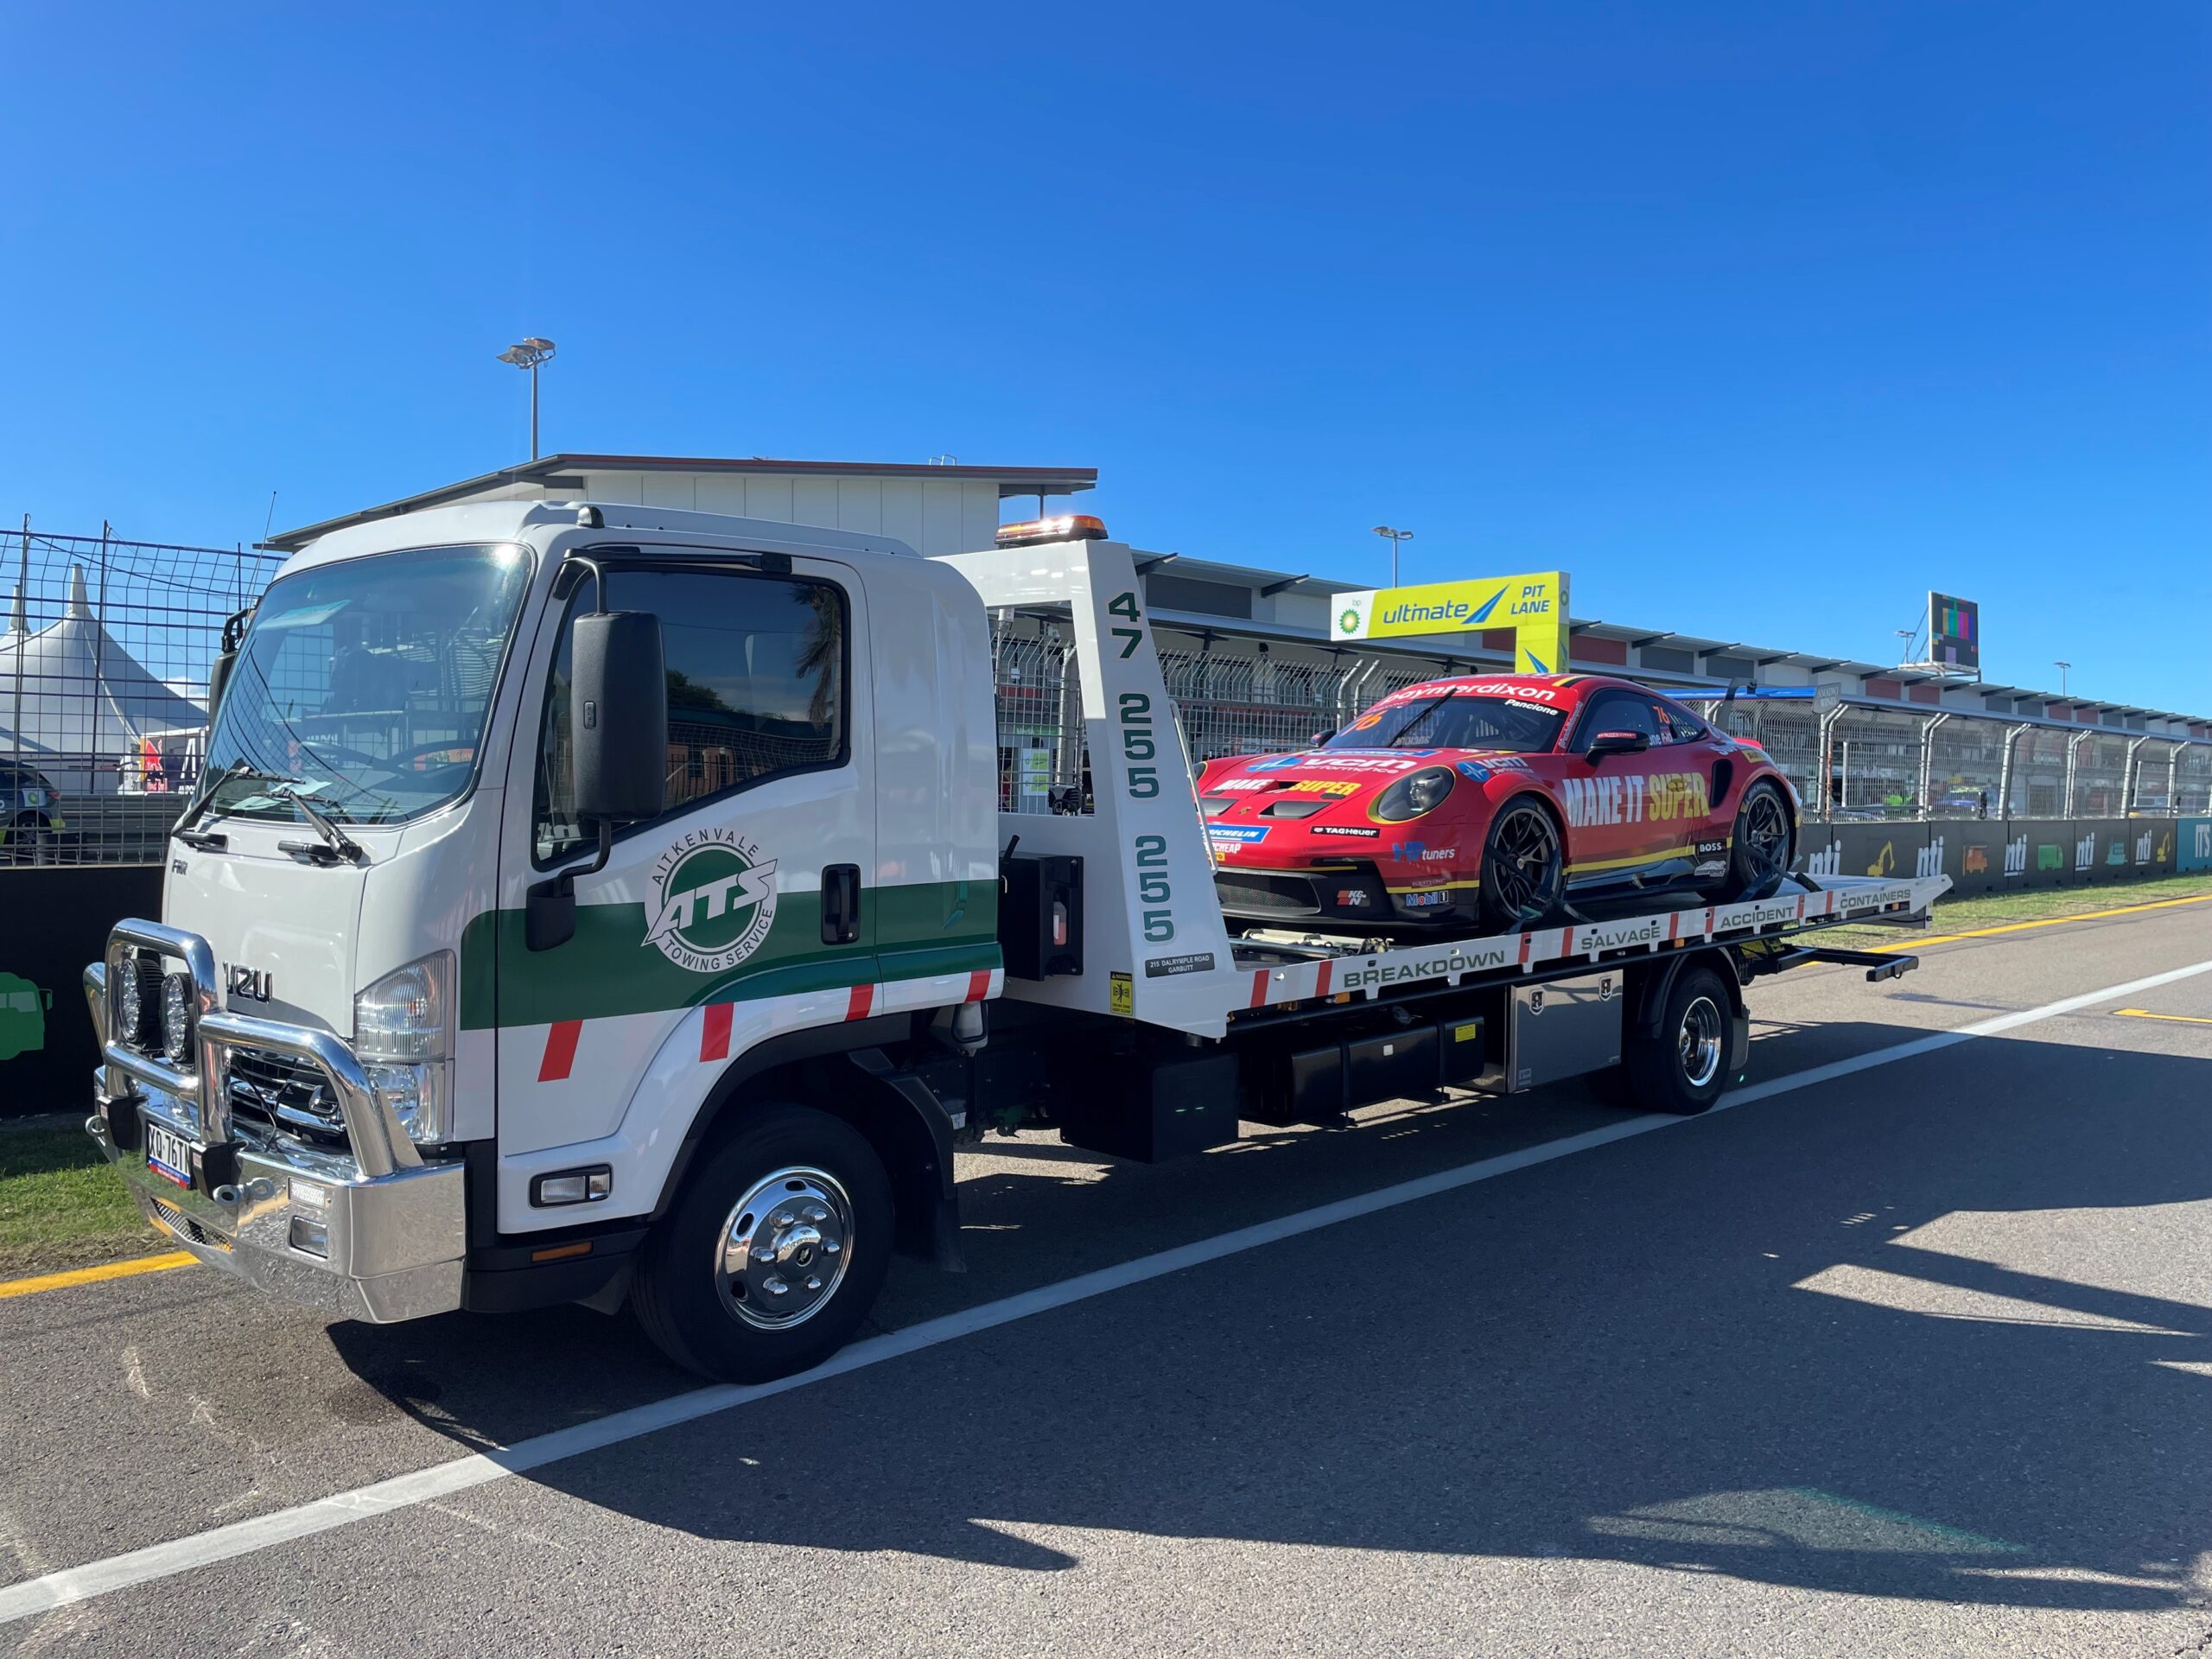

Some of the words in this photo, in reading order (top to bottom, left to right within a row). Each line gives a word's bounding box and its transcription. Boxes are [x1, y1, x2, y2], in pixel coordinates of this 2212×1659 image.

[1522, 584, 1546, 598] PIT
[1383, 600, 1469, 624] ultimate
[1510, 600, 1550, 615] LANE
[1380, 683, 1556, 705] paynterdixon
[1504, 699, 1559, 715] Pancione
[1652, 705, 1670, 725] 76
[1292, 765, 1399, 774] performance
[1304, 759, 1417, 769] vcm
[1475, 756, 1529, 769] vcm
[1213, 779, 1274, 791] MAKE
[1287, 779, 1362, 795] SUPER
[1562, 776, 1623, 828] MAKE
[1624, 774, 1644, 823] IT
[1649, 772, 1711, 822] SUPER
[652, 828, 759, 886] AITKENVALE
[1392, 840, 1425, 862] HP
[1421, 848, 1455, 861] tuners
[1700, 842, 1722, 853] BOSS
[1808, 839, 1841, 875] nti
[1916, 836, 1943, 878] nti
[2005, 834, 2027, 872] nti
[2075, 832, 2094, 867] nti
[640, 858, 778, 947] ATS
[1407, 892, 1438, 906] Mobil
[1840, 888, 1911, 910] CONTAINERS
[1721, 906, 1795, 929] ACCIDENT
[664, 939, 721, 971] TOWING
[727, 908, 772, 965] SERVICE
[1581, 925, 1661, 951] SALVAGE
[1161, 957, 1194, 966] DALRYMPLE
[1168, 964, 1193, 974] GARBUTT
[1344, 950, 1505, 988] BREAKDOWN
